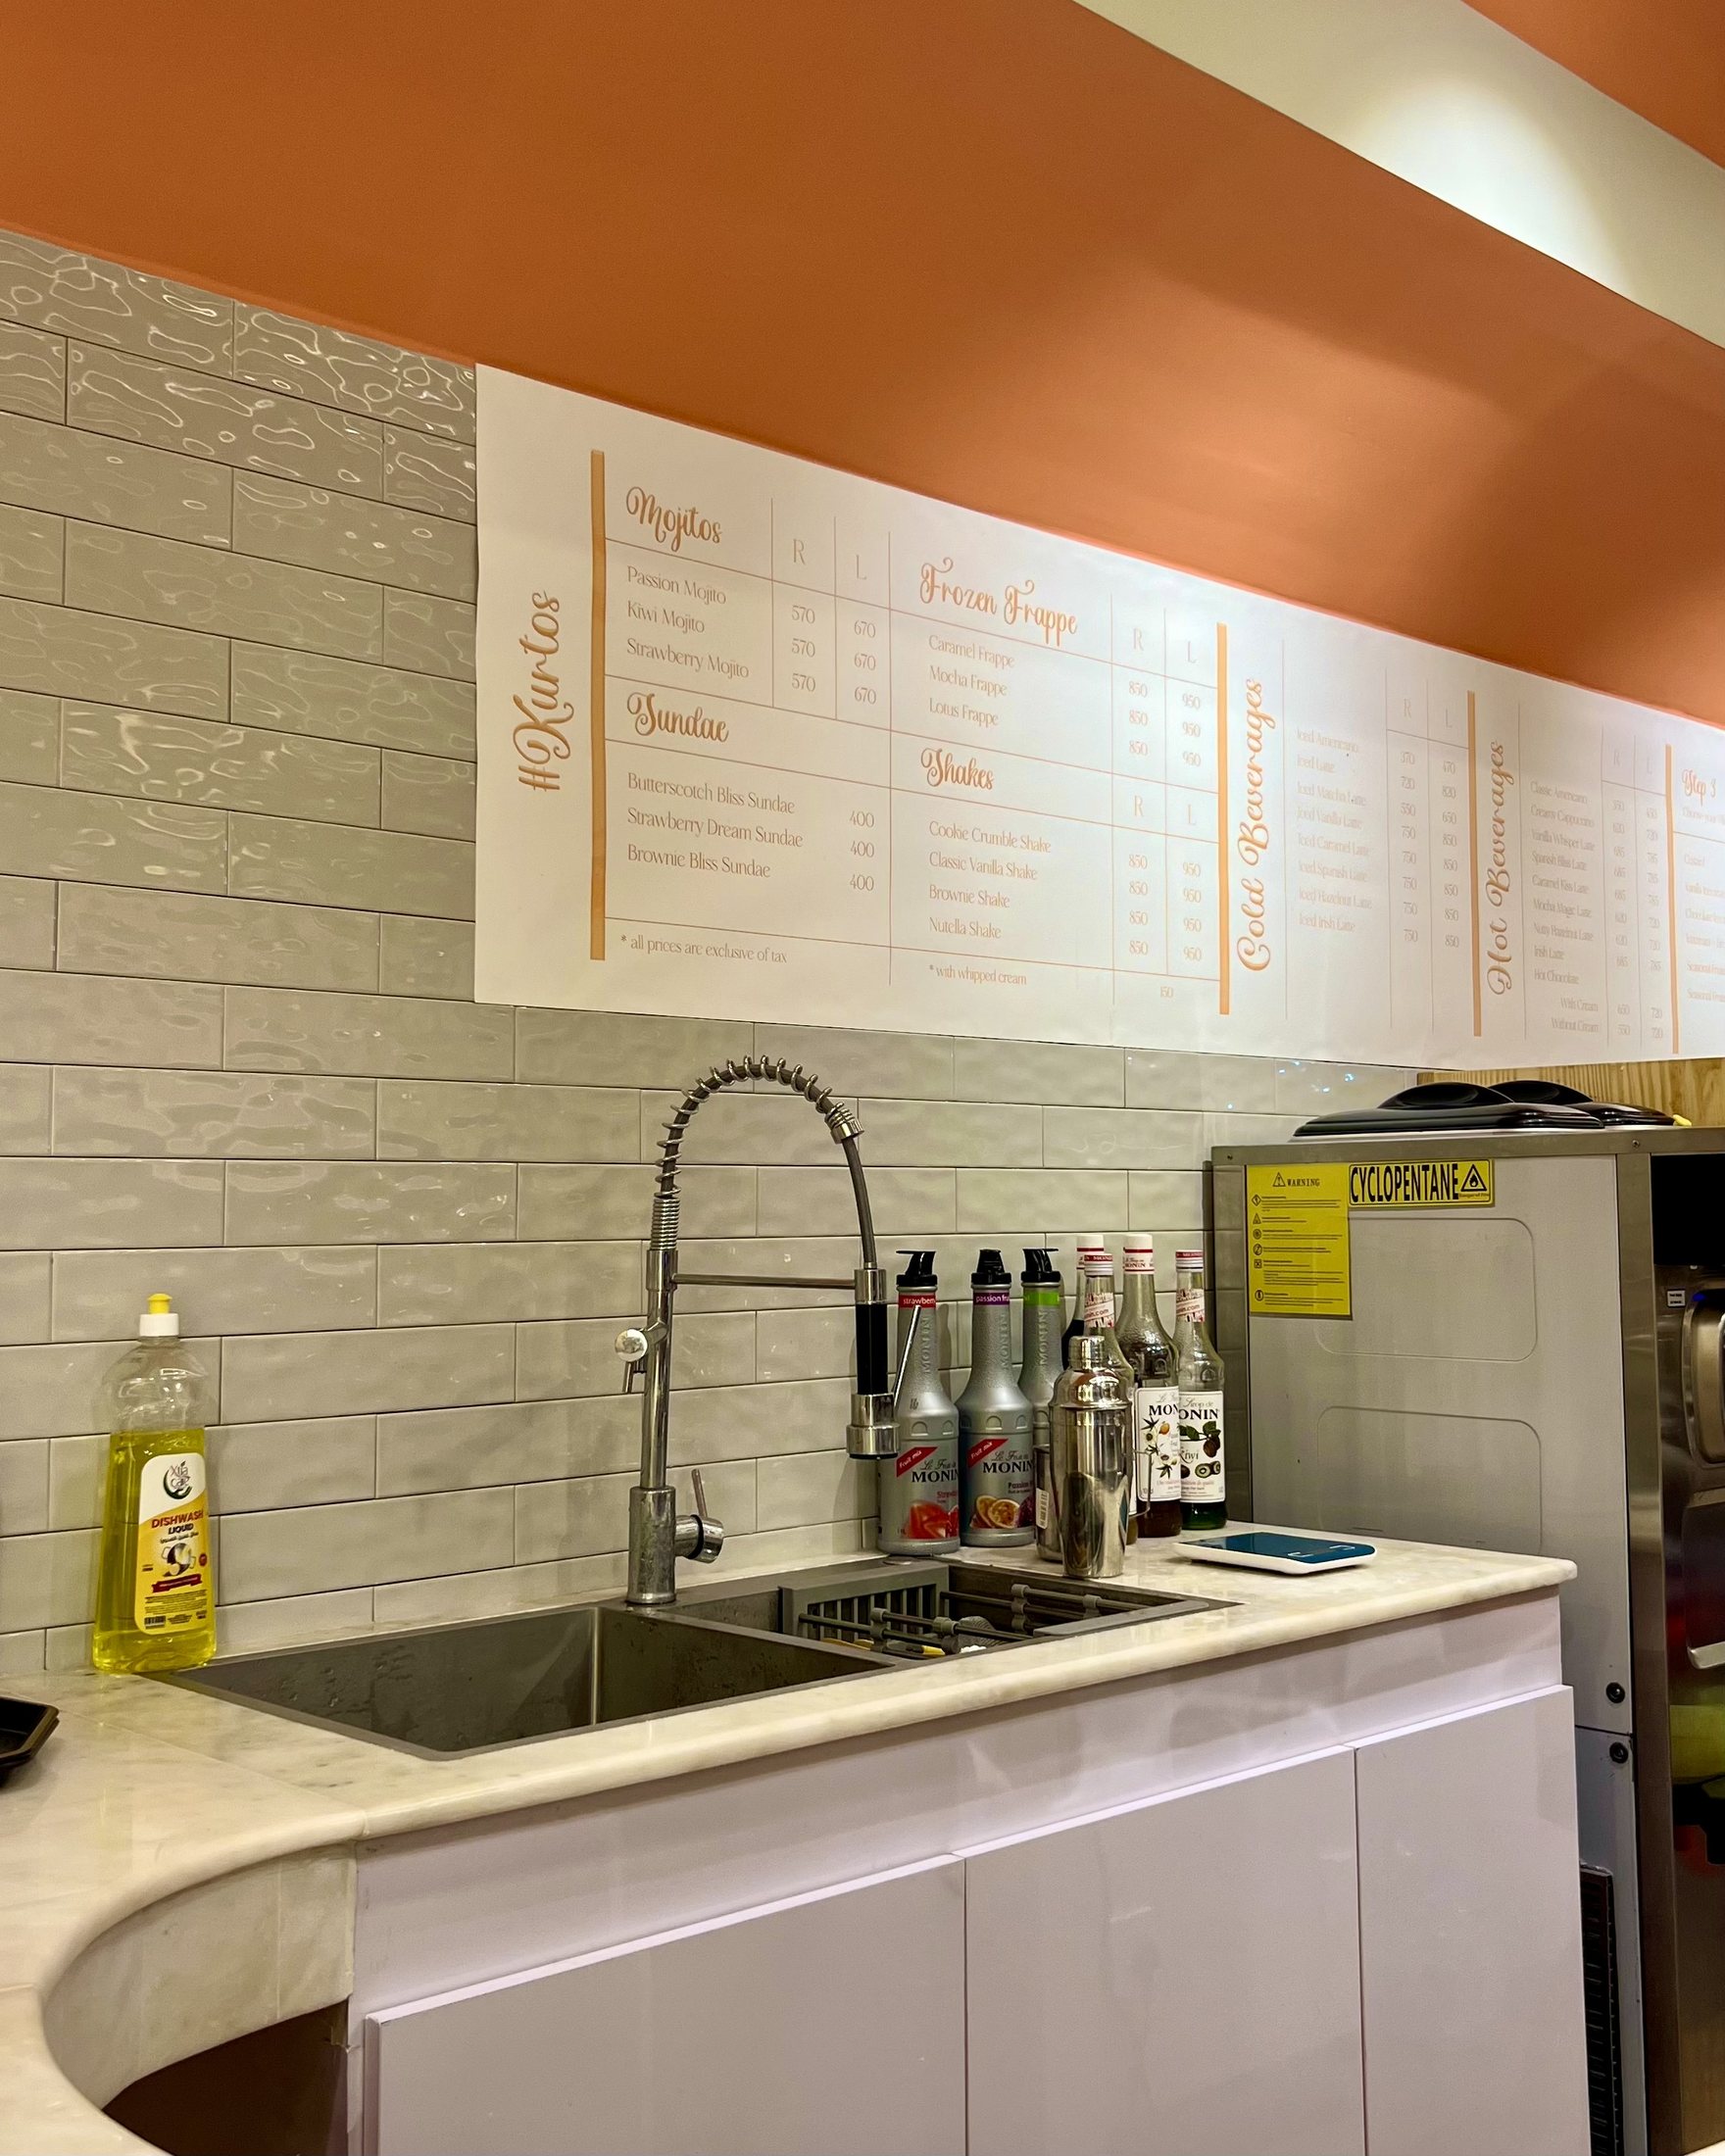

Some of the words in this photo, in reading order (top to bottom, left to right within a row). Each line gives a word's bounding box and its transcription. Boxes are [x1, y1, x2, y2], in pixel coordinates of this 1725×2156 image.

[626, 486, 722, 552] Mojitos
[793, 538, 806, 565] R
[856, 555, 867, 580] L
[627, 565, 679, 593] Passion
[685, 579, 726, 606] Mojito
[920, 557, 997, 615] Frozen
[1004, 579, 1078, 647] Frappe
[627, 602, 658, 624] Kiwi
[662, 609, 705, 634] Mojito
[791, 606, 815, 625] 570
[854, 619, 876, 638] 670
[1133, 627, 1144, 652] R
[627, 638, 704, 673] Strawberry
[708, 655, 750, 679] Mojito
[791, 639, 815, 658] 570
[929, 635, 976, 658] Caramel
[978, 646, 1015, 669] Frappe
[1188, 640, 1197, 663] L
[854, 653, 876, 671] 670
[791, 673, 815, 693] 570
[930, 665, 967, 687] Mocha
[970, 673, 1008, 698] Frappe
[1128, 682, 1148, 698] 850
[854, 686, 876, 705] 670
[1182, 693, 1201, 710] 950
[627, 692, 729, 743] Sundae
[930, 698, 959, 717] Lotus
[962, 705, 999, 728] Frappe
[1129, 710, 1148, 726] 850
[1404, 698, 1411, 718] R
[1445, 709, 1453, 728] L
[1183, 722, 1201, 737] 950
[1129, 740, 1148, 757] 850
[920, 748, 994, 791] Shakes
[1237, 678, 1275, 866] Beverages
[628, 772, 714, 803] Butterscotch
[717, 787, 745, 807] Bliss
[748, 795, 795, 814] Sundae
[1134, 795, 1144, 817] R
[1188, 804, 1197, 825] L
[627, 808, 704, 838] Strawberry
[708, 819, 752, 840] Dream
[756, 826, 804, 848] Sundae
[850, 809, 874, 827] 400
[1486, 741, 1513, 907] Beverages
[929, 820, 968, 840] Cookie
[971, 827, 1017, 849] Crumble
[1020, 835, 1051, 853] Shake
[850, 840, 874, 858] 400
[628, 845, 685, 868] Brownie
[689, 854, 718, 871] Bliss
[721, 858, 770, 879] Sundae
[929, 852, 966, 870] Classic
[969, 858, 1004, 875] Vanilla
[1007, 861, 1037, 880] Shake
[1128, 854, 1148, 869] 850
[1183, 862, 1201, 877] 950
[850, 873, 874, 892] 400
[1129, 880, 1148, 896] 850
[930, 884, 974, 905] Brownie
[977, 890, 1010, 908] Shake
[930, 917, 965, 935] Nutella
[969, 922, 1001, 939] Shake
[1129, 910, 1148, 925] 850
[1183, 917, 1202, 932] 950
[1236, 878, 1271, 971] Cold
[630, 935, 644, 950] all
[647, 937, 681, 956] prices
[685, 942, 703, 956] are
[706, 942, 754, 961] exclusive
[757, 947, 769, 961] of
[771, 951, 787, 963] tax
[1129, 941, 1148, 955] 850
[1487, 917, 1512, 995] Hot
[936, 965, 956, 978] with
[958, 966, 996, 984] whipped
[998, 968, 1026, 985] cream
[1287, 1178, 1320, 1187] WARNING
[1351, 1163, 1459, 1202] CYCLOPENTANE
[1179, 1409, 1218, 1419] ONIN
[152, 1510, 204, 1528] DISHWASH
